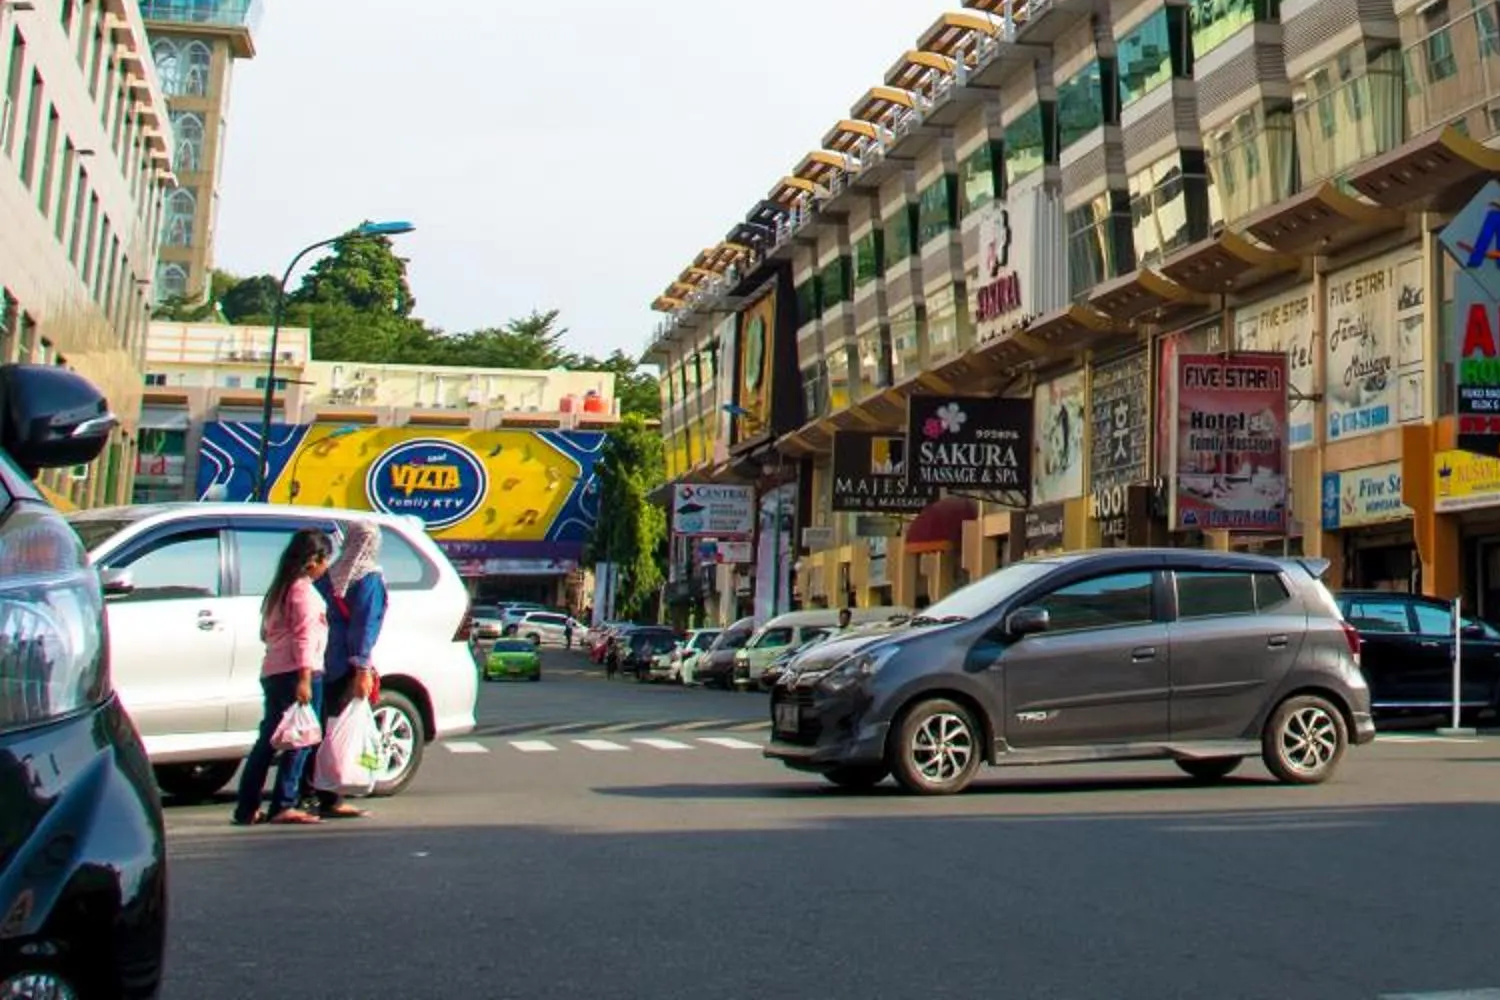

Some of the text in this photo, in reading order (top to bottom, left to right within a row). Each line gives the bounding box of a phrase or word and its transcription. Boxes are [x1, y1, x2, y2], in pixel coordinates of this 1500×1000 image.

[1329, 284, 1352, 308] FIVE
[1354, 270, 1385, 299] STAR
[1259, 304, 1280, 328] FIVE
[1281, 297, 1309, 324] STAR
[1330, 310, 1371, 352] Family
[1184, 364, 1221, 390] FIVE
[1224, 366, 1268, 391] STAR
[1344, 355, 1392, 387] Massage
[1190, 411, 1245, 431] Hotel
[1189, 434, 1223, 452] Family
[919, 441, 1020, 468] SAKURA
[919, 466, 1019, 485] MASSAGE & SPA
[696, 485, 750, 502] CENTRAL
[1359, 477, 1385, 499] Five
[388, 497, 464, 510] Family KTV
[1015, 710, 1048, 721] TRD
